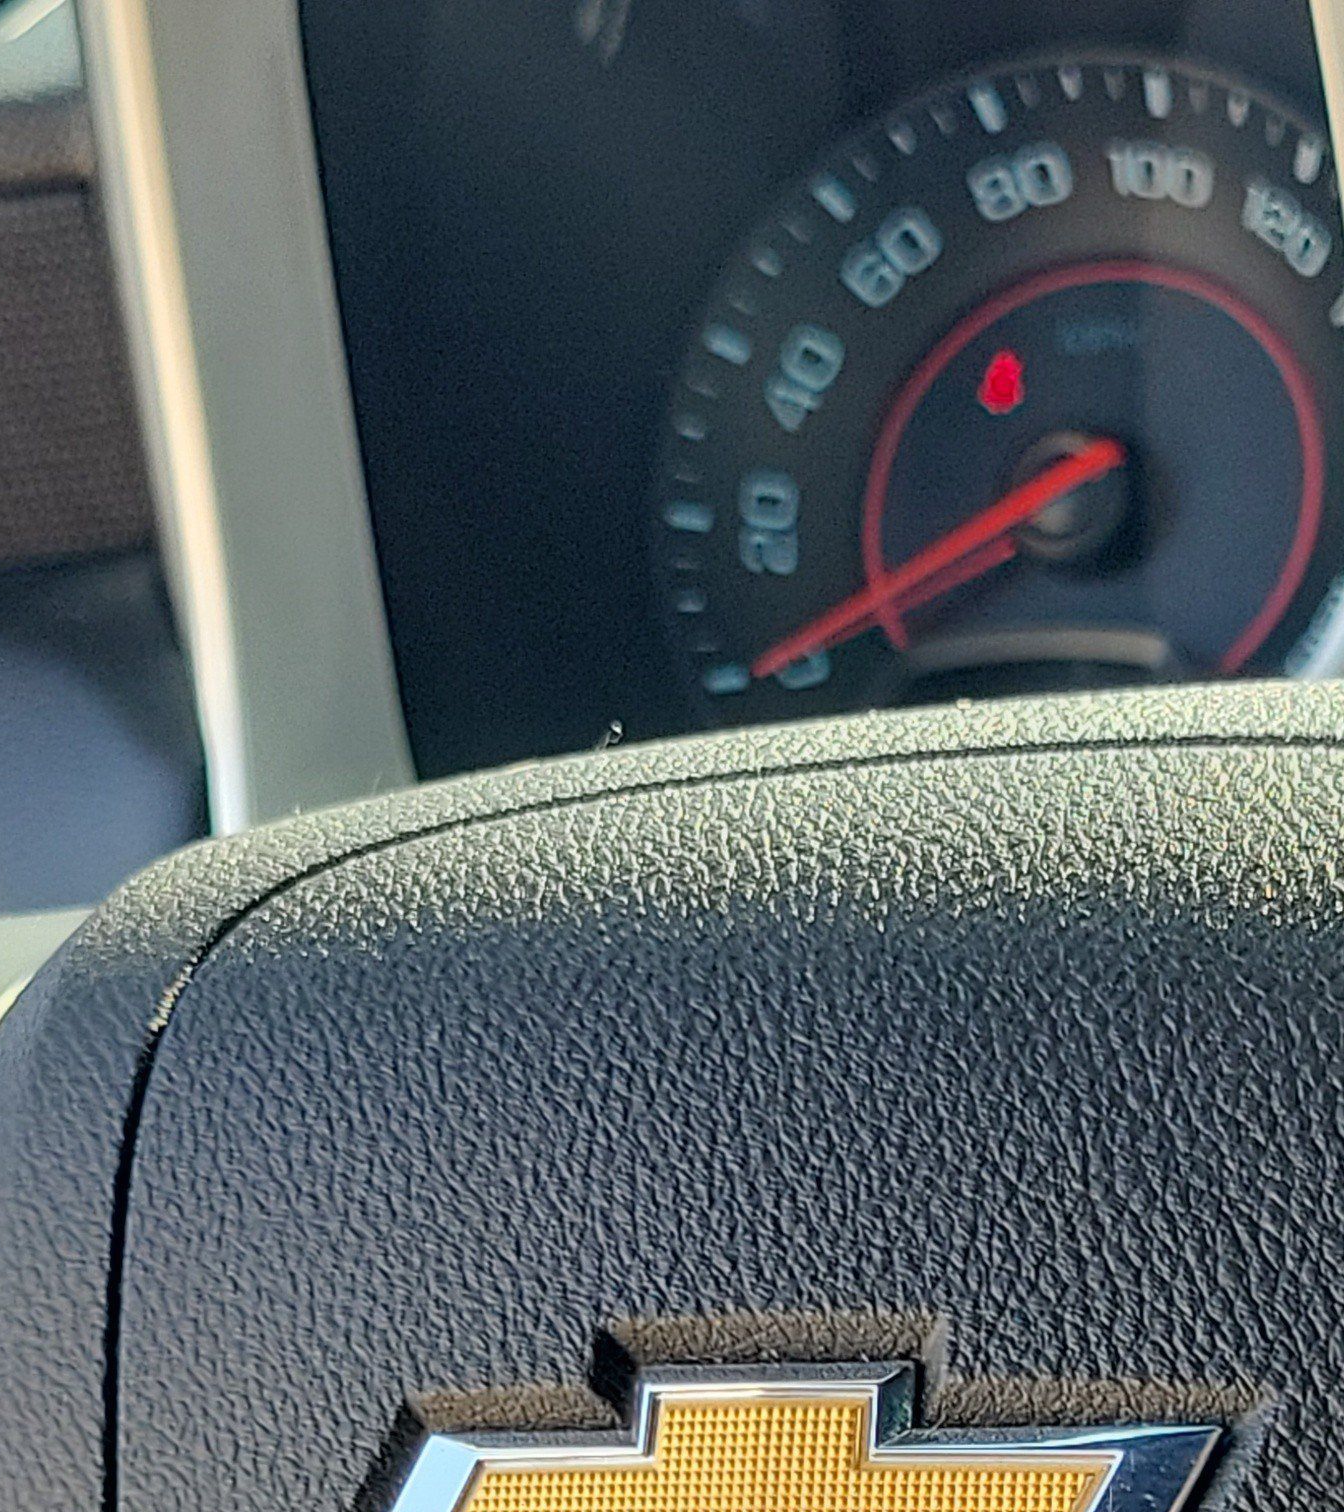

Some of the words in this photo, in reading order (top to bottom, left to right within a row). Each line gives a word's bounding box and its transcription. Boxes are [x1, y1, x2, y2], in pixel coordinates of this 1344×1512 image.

[967, 141, 1073, 221] 80
[1109, 139, 1214, 208] 100
[841, 205, 943, 307] 60
[1242, 183, 1331, 279] 120
[764, 323, 845, 432] 40
[738, 469, 801, 575] 20
